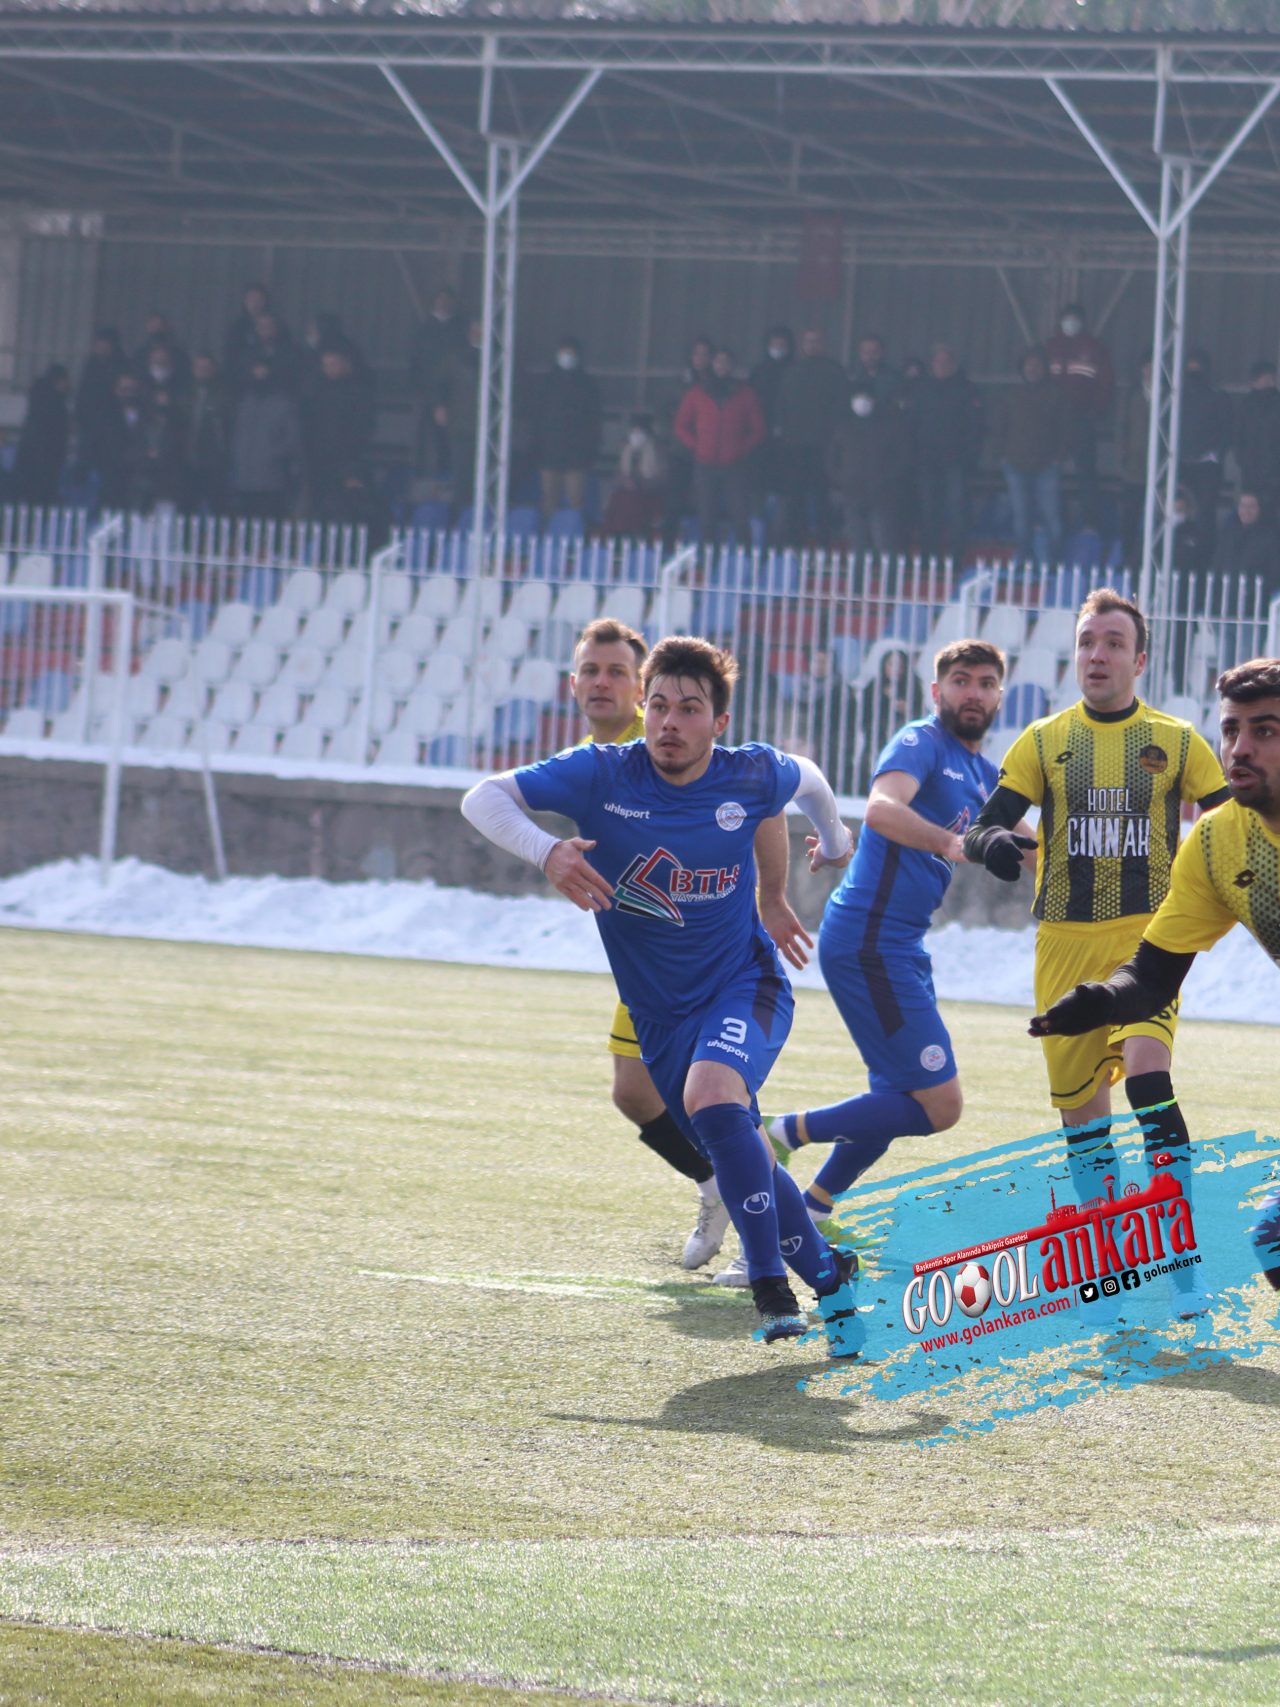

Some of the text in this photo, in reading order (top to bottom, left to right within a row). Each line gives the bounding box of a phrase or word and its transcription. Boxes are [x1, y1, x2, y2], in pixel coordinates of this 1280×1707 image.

[604, 802, 650, 820] uhlsport
[1088, 788, 1132, 812] HOTEL
[669, 864, 740, 895] BTH
[720, 1017, 747, 1044] 3
[706, 1039, 750, 1063] uhlsport
